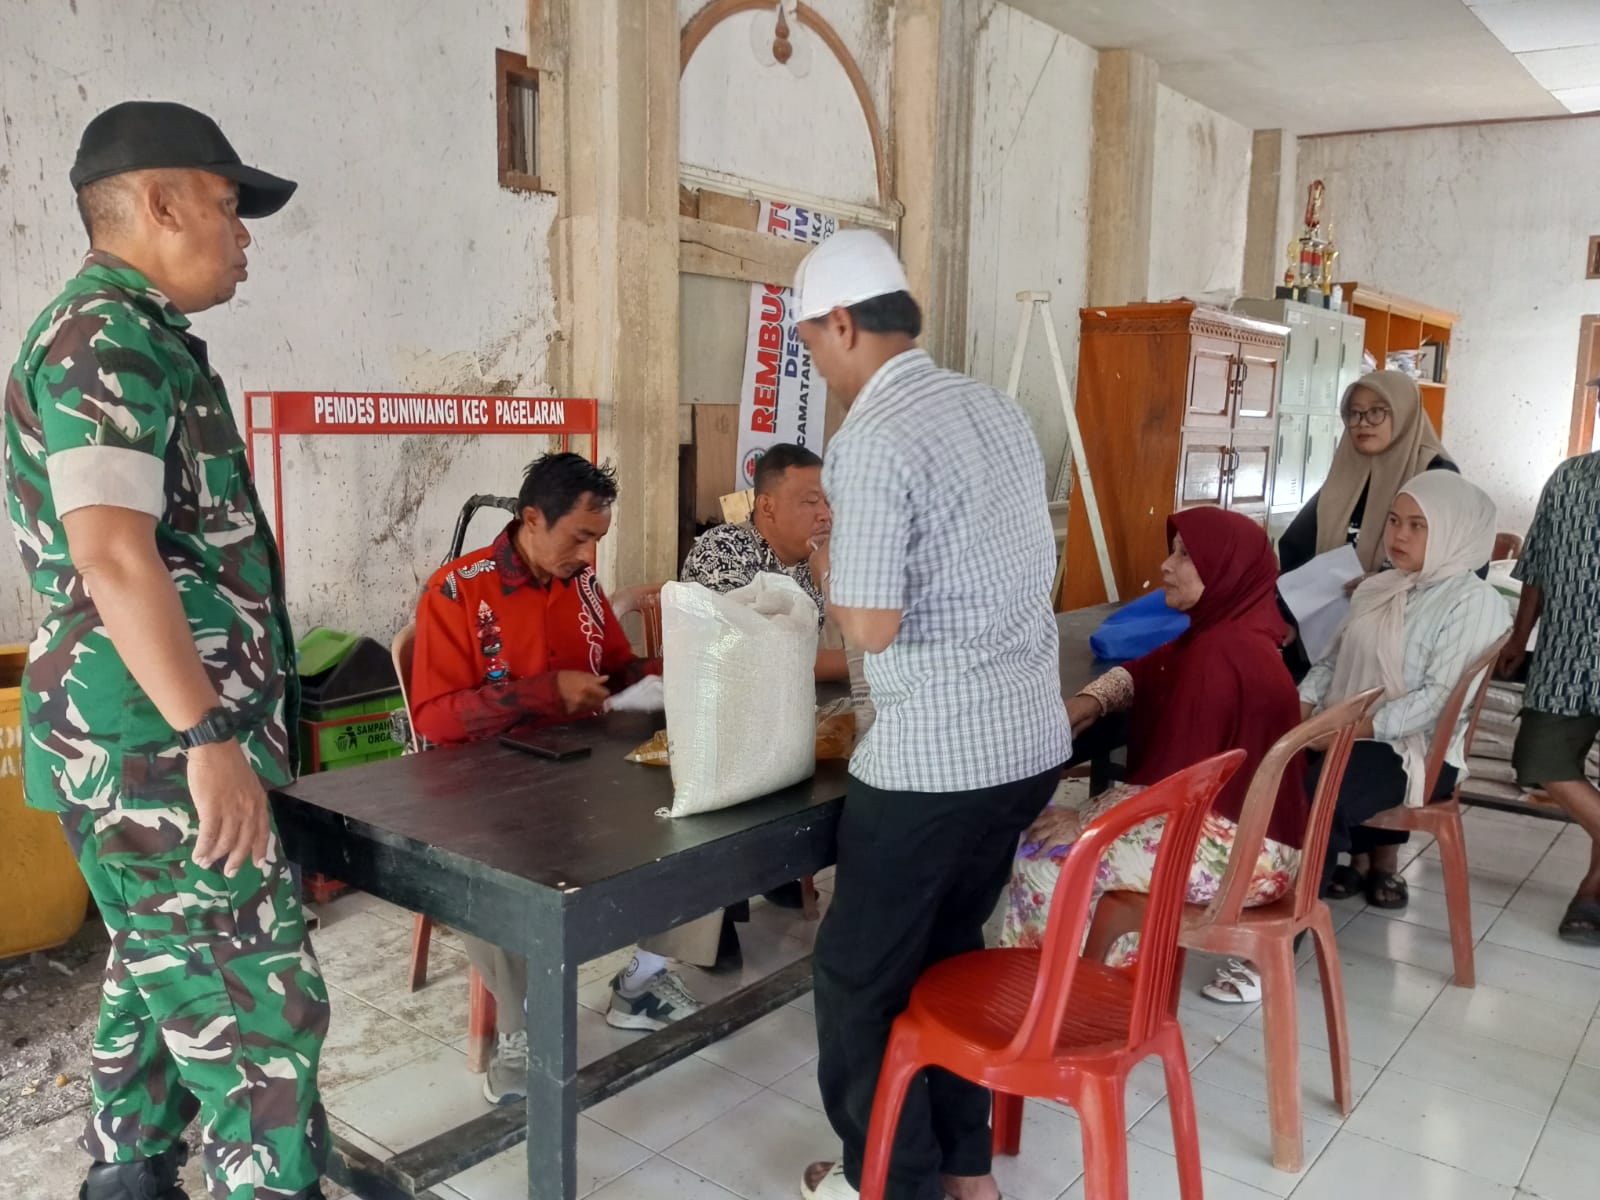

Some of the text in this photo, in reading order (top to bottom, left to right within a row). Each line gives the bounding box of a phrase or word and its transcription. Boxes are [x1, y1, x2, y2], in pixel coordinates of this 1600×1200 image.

[314, 396, 565, 425] PEMDES BUNIWANGI KEC PAGELARAN
[796, 352, 811, 447] CAMATAN
[367, 731, 391, 745] ORGA
